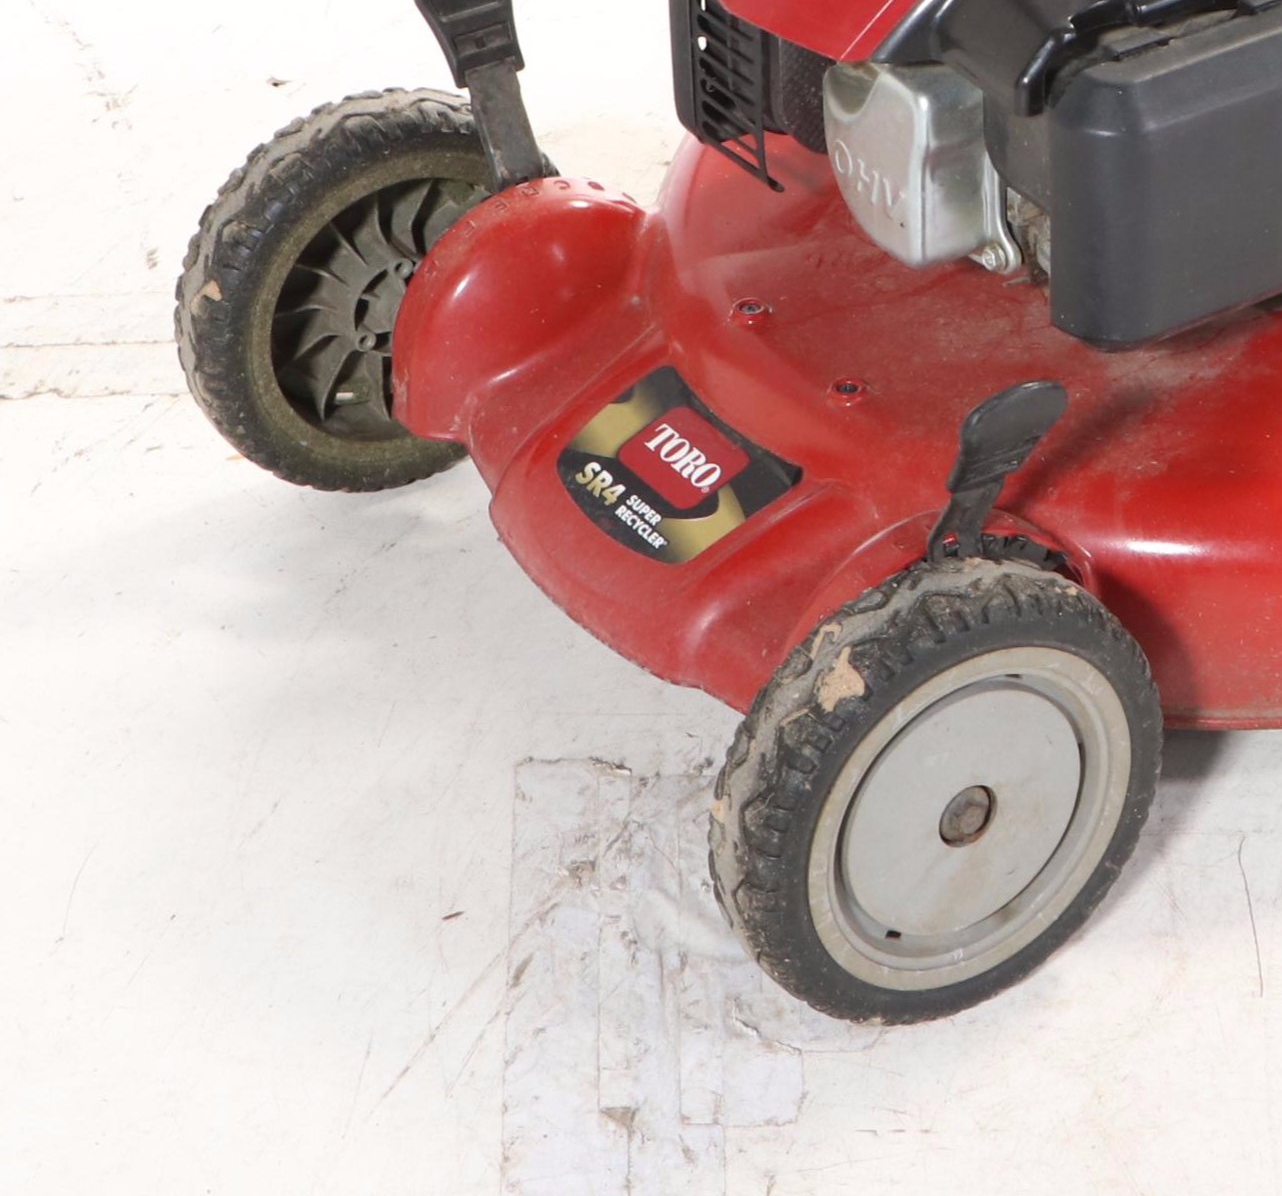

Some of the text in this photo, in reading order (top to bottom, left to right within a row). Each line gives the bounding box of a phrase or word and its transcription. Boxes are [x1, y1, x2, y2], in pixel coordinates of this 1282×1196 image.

[643, 422, 722, 490] TORO
[574, 461, 627, 507] SR4
[625, 494, 663, 527] SUPER
